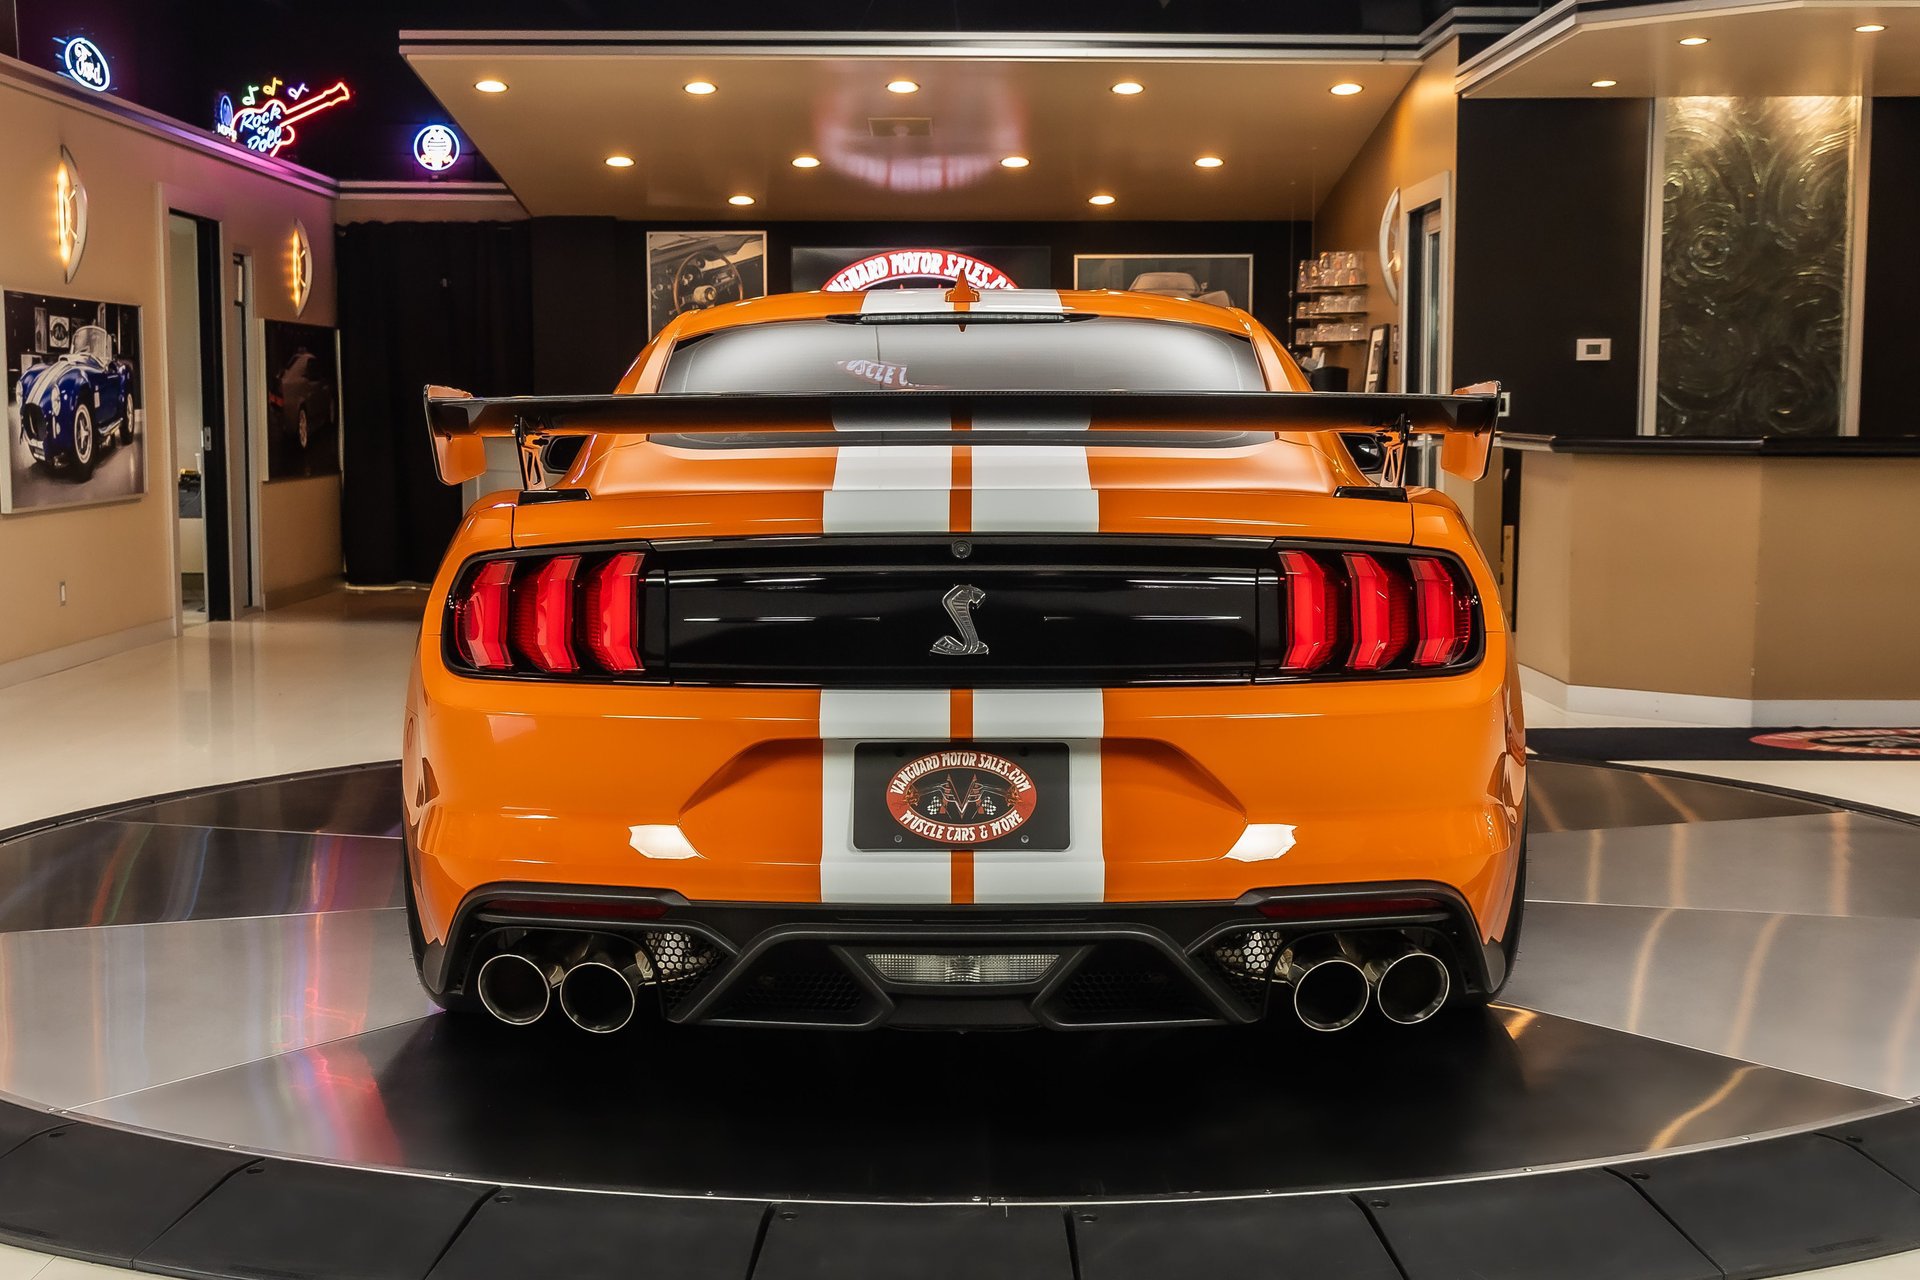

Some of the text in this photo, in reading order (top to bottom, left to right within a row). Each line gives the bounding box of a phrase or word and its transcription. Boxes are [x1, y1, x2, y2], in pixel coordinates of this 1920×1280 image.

[74, 43, 103, 85] Ford
[239, 102, 282, 132] Rock
[889, 252, 943, 275] MOTOR
[943, 254, 1015, 289] SALES.C
[890, 752, 1032, 795] VANGUARD MOTOR SALES.COM
[900, 810, 1023, 842] MUSCLE CARS & MORE
